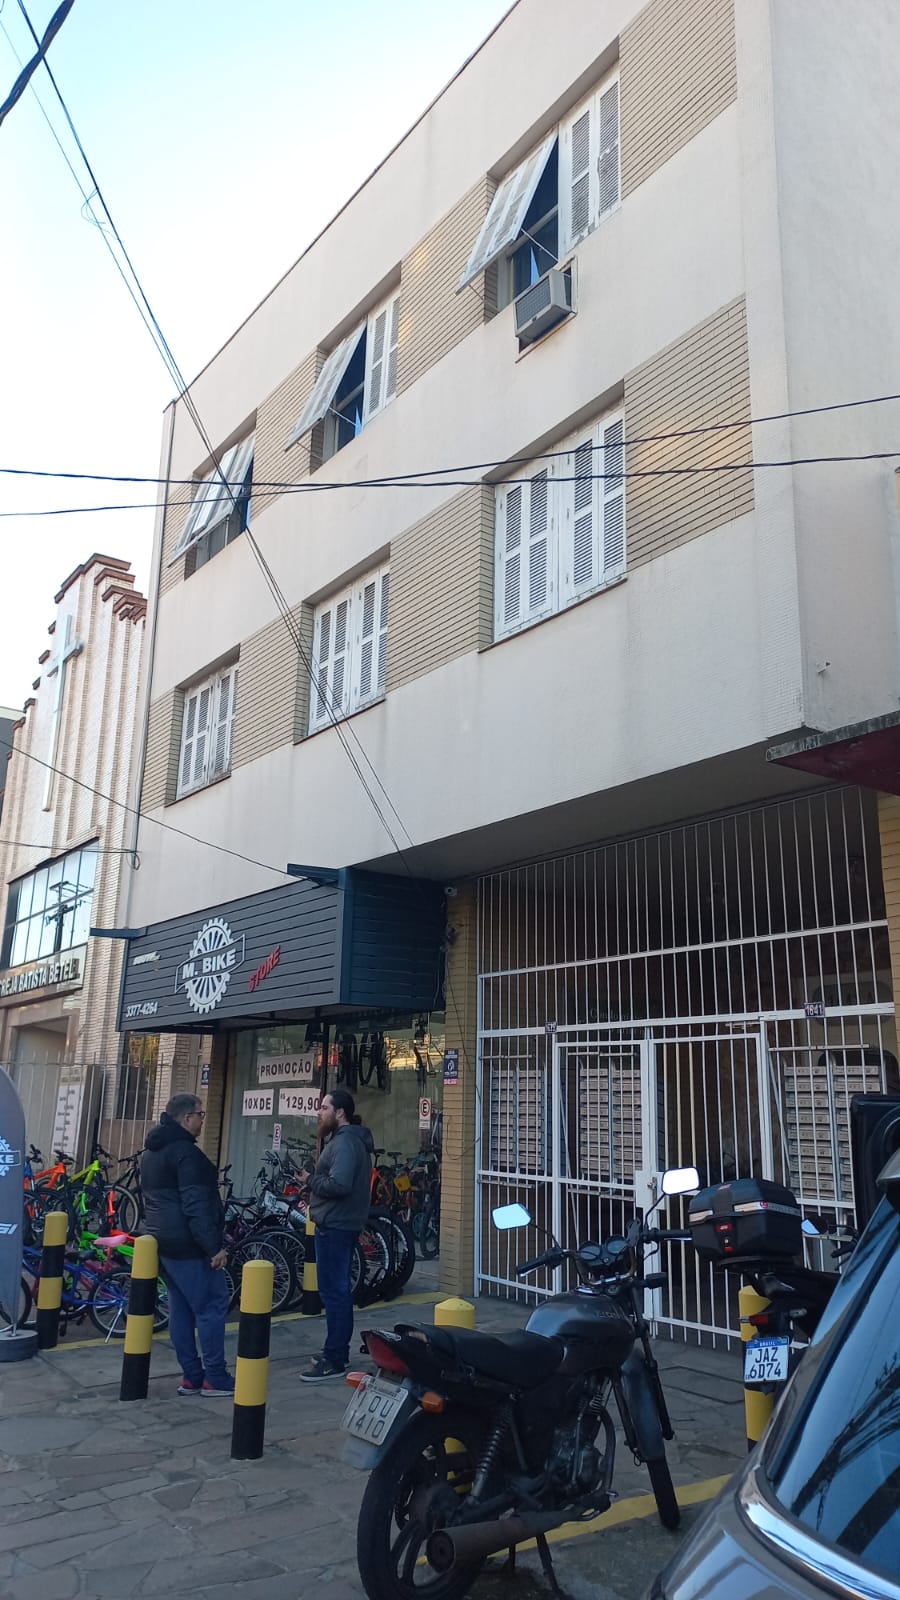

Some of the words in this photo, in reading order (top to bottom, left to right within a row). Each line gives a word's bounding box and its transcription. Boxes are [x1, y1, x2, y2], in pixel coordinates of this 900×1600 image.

[19, 965, 48, 992] BATISTA
[48, 957, 77, 985] BETEL
[182, 961, 199, 979] M.
[202, 948, 237, 974] BIKE
[249, 944, 281, 993] STORE
[806, 1003, 823, 1016] 1641
[286, 1095, 321, 1113] 129,90
[755, 1346, 779, 1363] JAZ
[750, 1361, 782, 1379] 6D74
[346, 1409, 386, 1439] 1410
